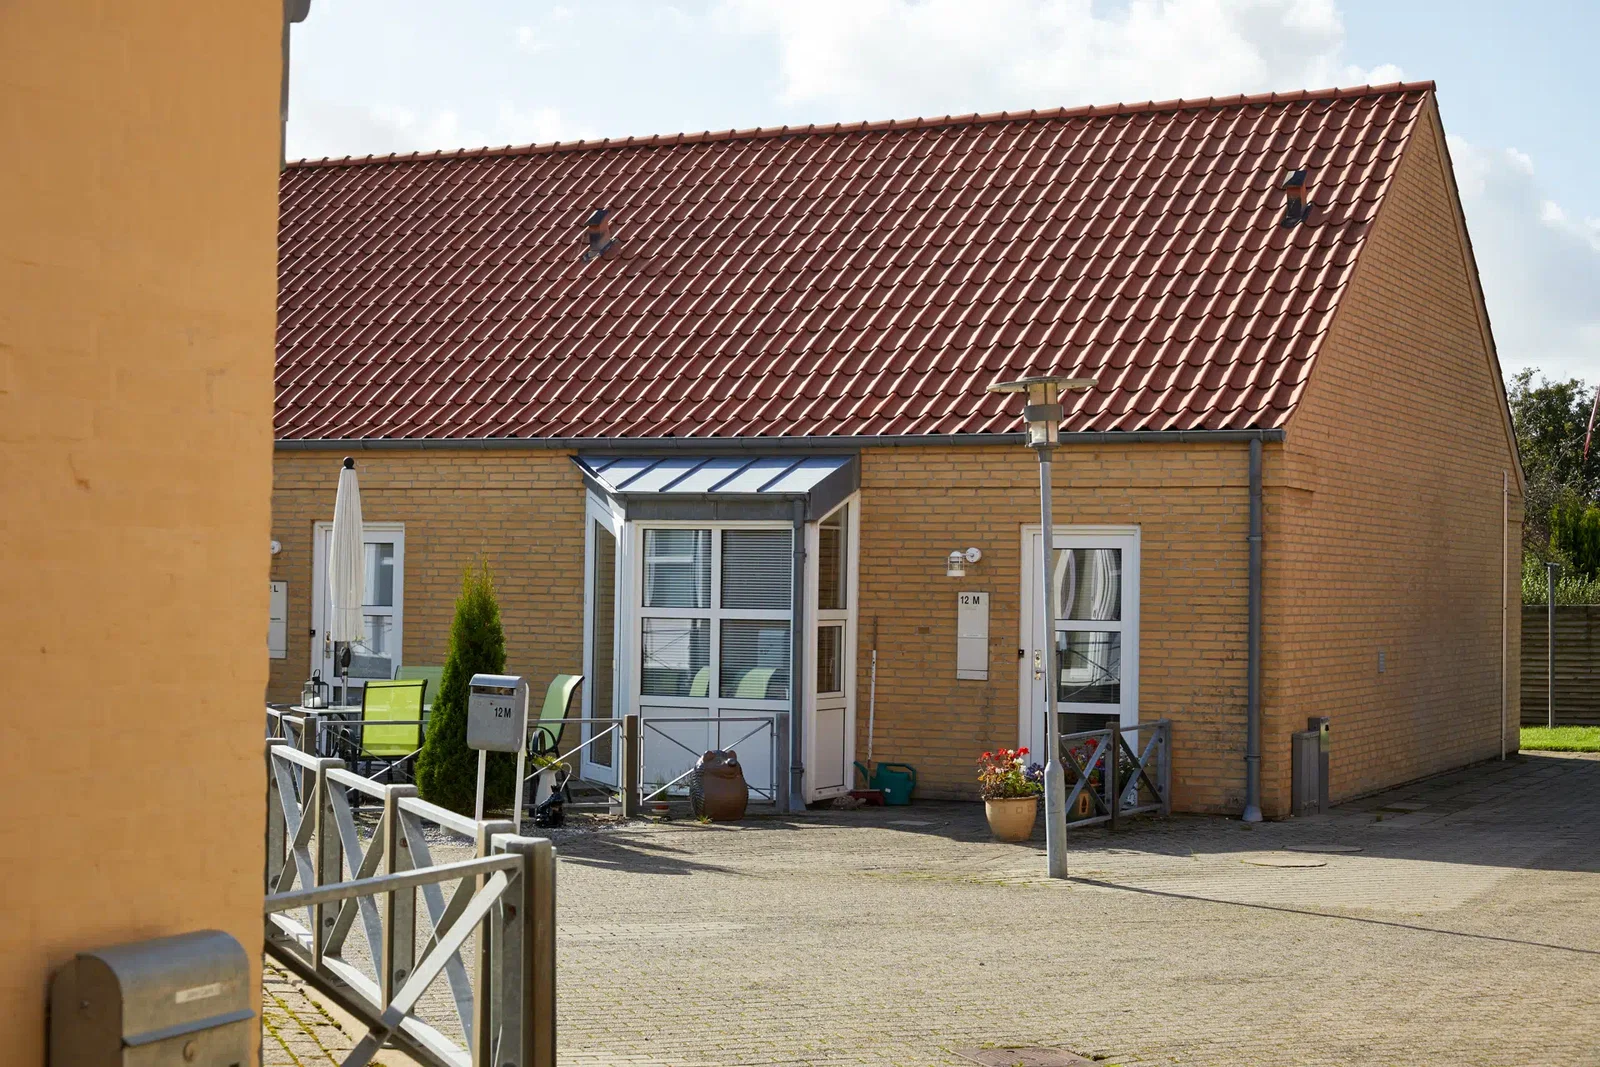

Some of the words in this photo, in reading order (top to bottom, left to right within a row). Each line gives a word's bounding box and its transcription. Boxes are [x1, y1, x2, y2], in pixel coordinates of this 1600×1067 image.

[273, 584, 279, 593] L
[960, 595, 969, 605] 12
[972, 595, 980, 605] M
